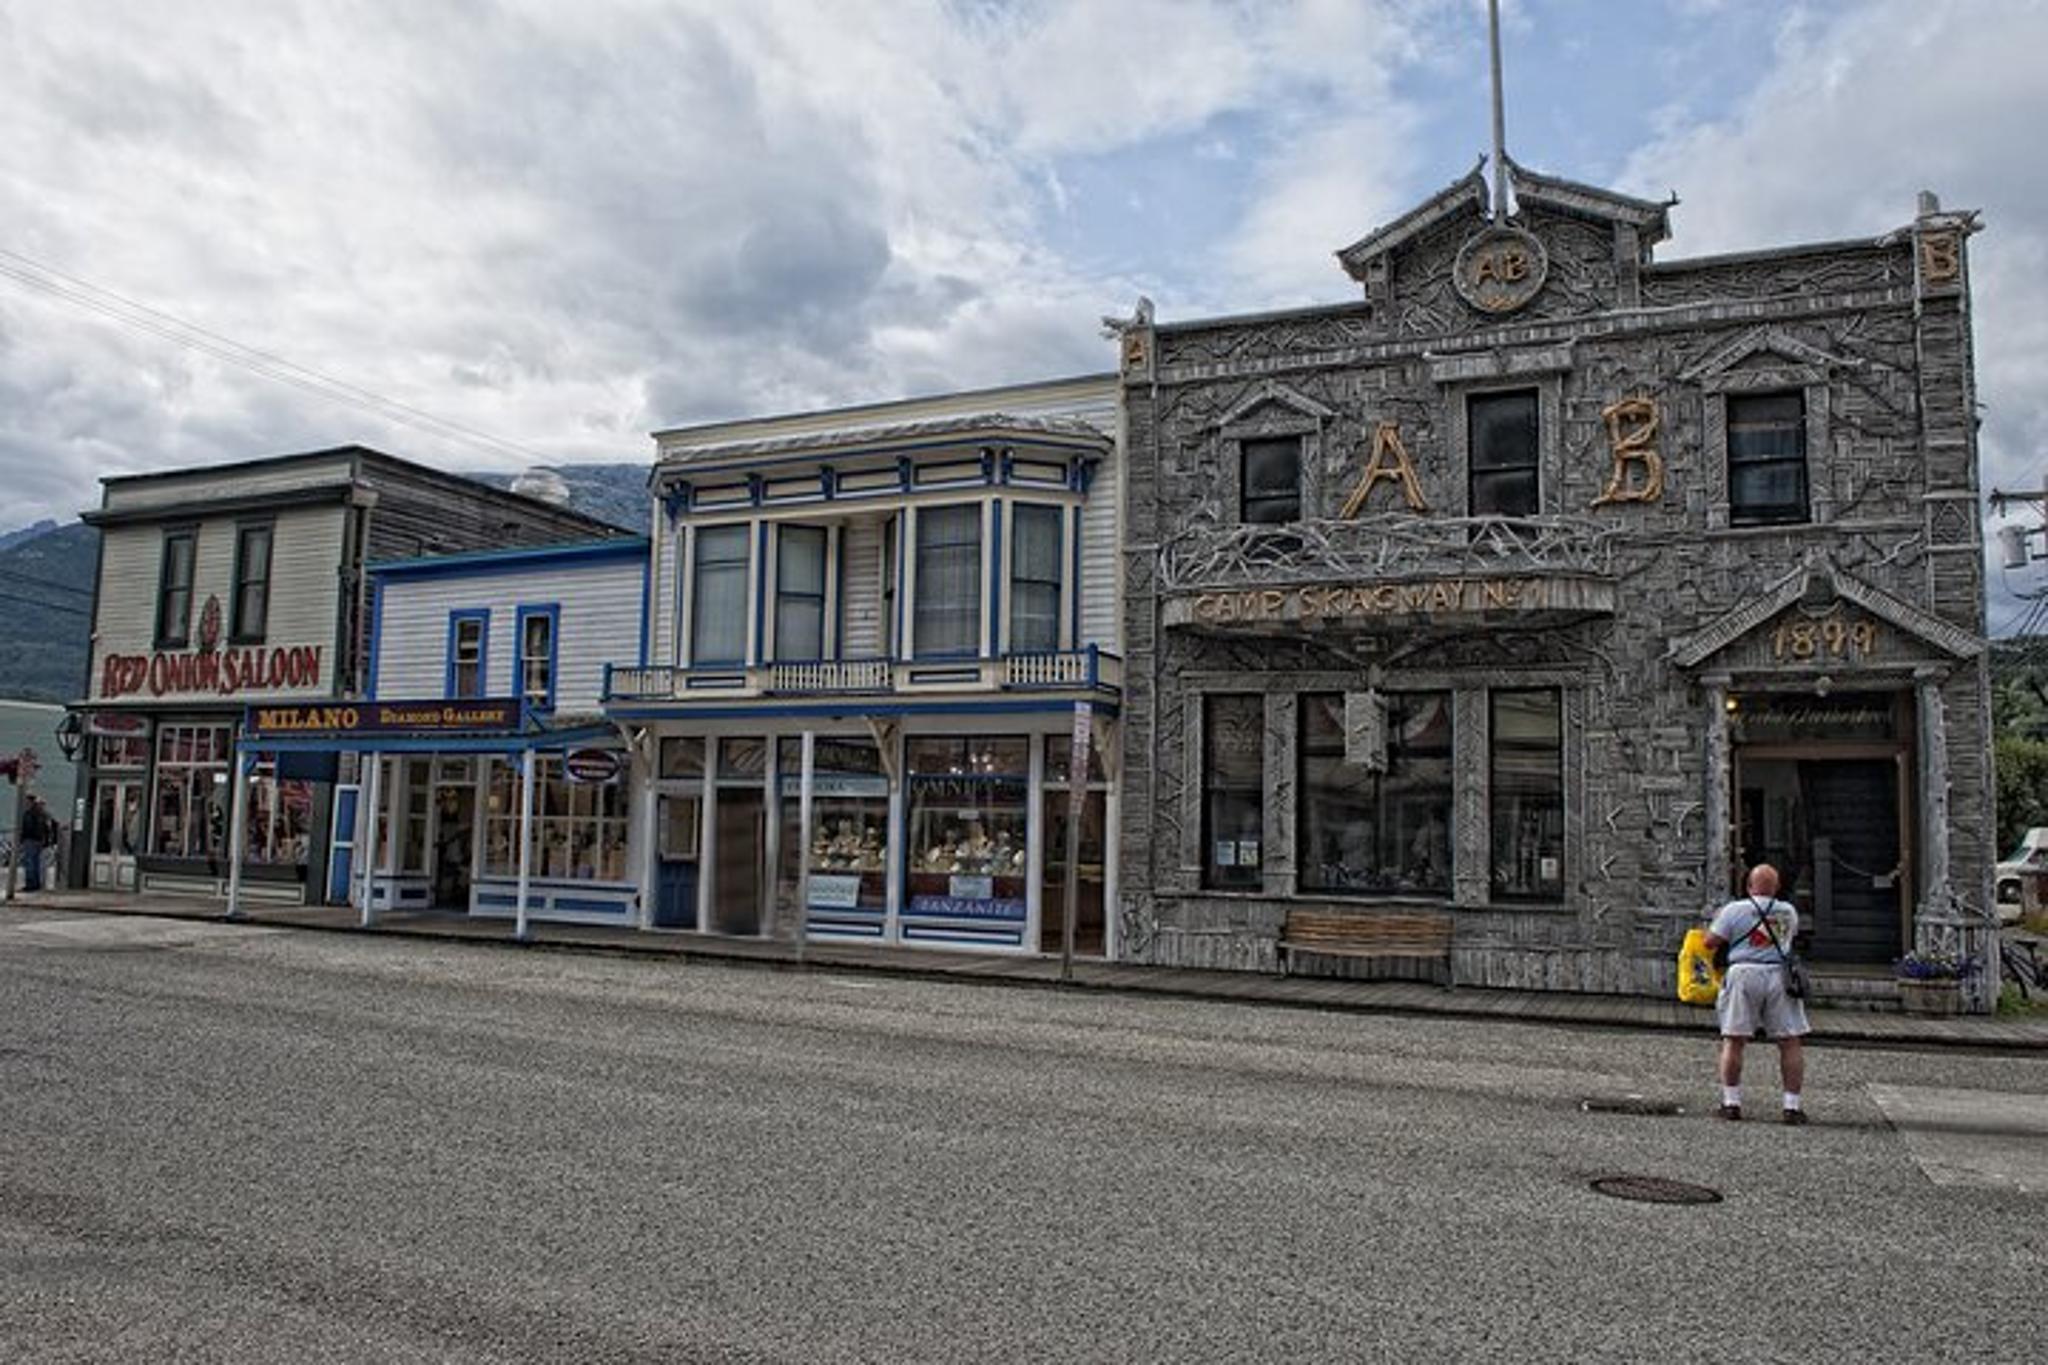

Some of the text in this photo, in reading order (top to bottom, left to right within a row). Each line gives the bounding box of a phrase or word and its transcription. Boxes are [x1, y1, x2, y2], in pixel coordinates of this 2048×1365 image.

[1339, 422, 1428, 520] A
[1589, 396, 1665, 511] B
[1194, 590, 1285, 620] CAMP
[1768, 619, 1878, 659] 1899
[101, 645, 322, 699] RED ONION SALOON
[257, 707, 360, 729] MILANO
[442, 706, 505, 724] GALLERY
